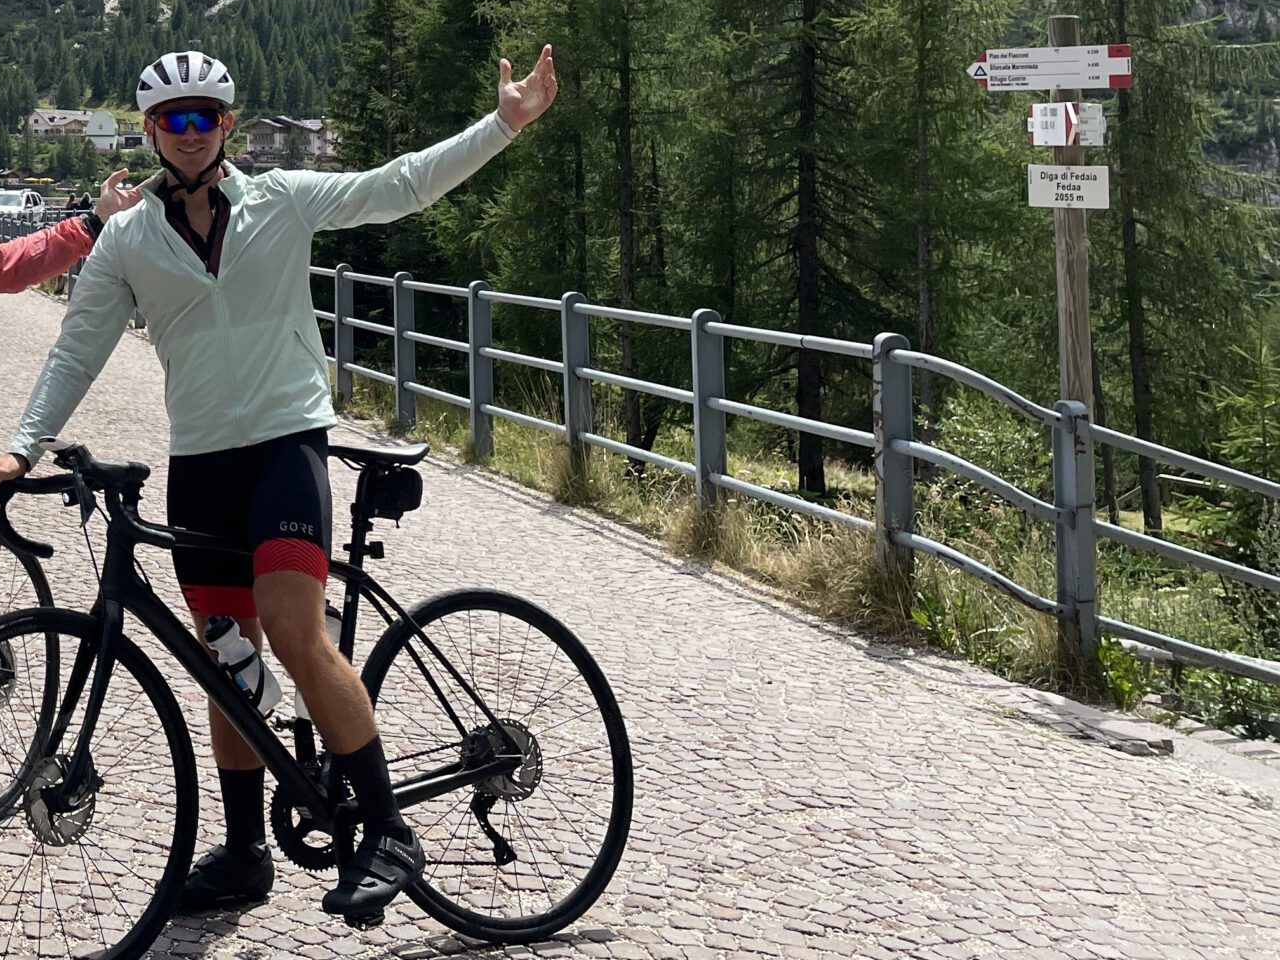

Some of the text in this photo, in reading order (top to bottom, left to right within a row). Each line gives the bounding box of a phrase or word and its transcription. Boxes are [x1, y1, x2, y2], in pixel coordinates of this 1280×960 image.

[1040, 171, 1058, 182] Diga
[1061, 172, 1068, 180] di
[1070, 172, 1098, 181] Fedaia
[1056, 182, 1081, 191] Fedaa
[1054, 193, 1084, 202] 2055 m
[279, 521, 315, 536] GORE
